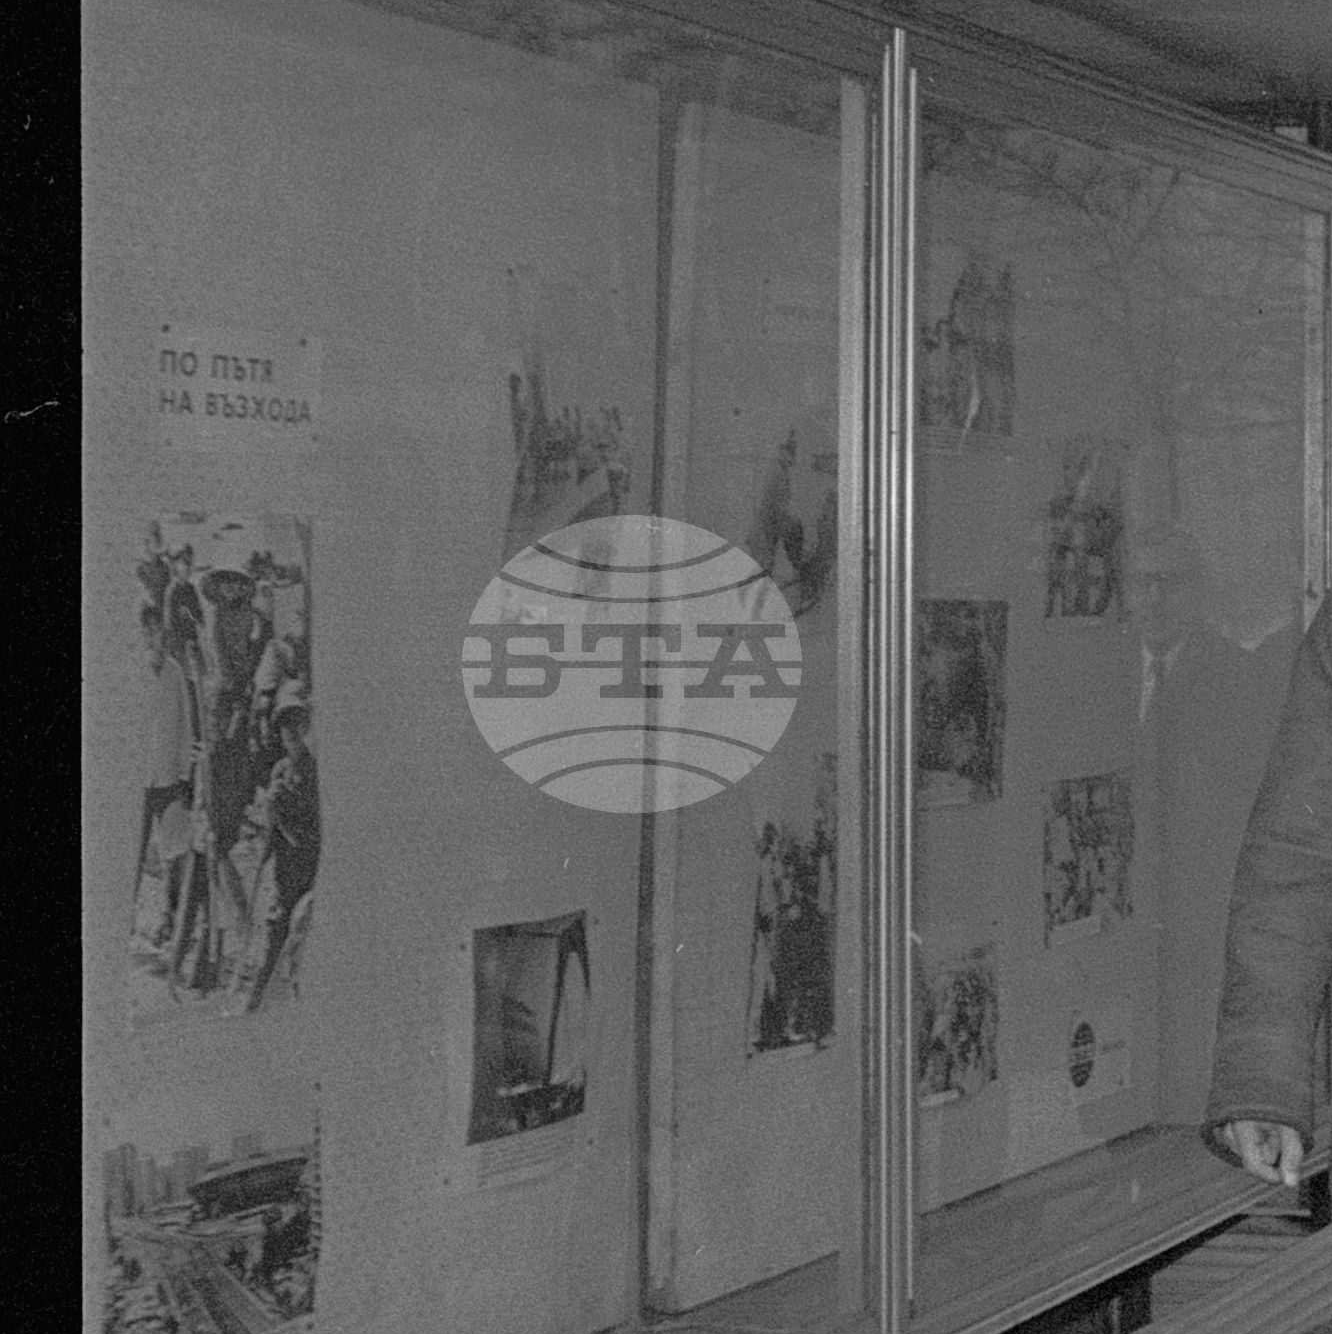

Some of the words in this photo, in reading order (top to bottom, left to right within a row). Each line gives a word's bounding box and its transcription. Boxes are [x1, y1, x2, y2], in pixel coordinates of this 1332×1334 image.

[159, 349, 198, 377] ПО
[211, 353, 273, 383] ПЪТЯ
[159, 389, 193, 415] НА
[206, 392, 311, 424] ВЪЗХОДА
